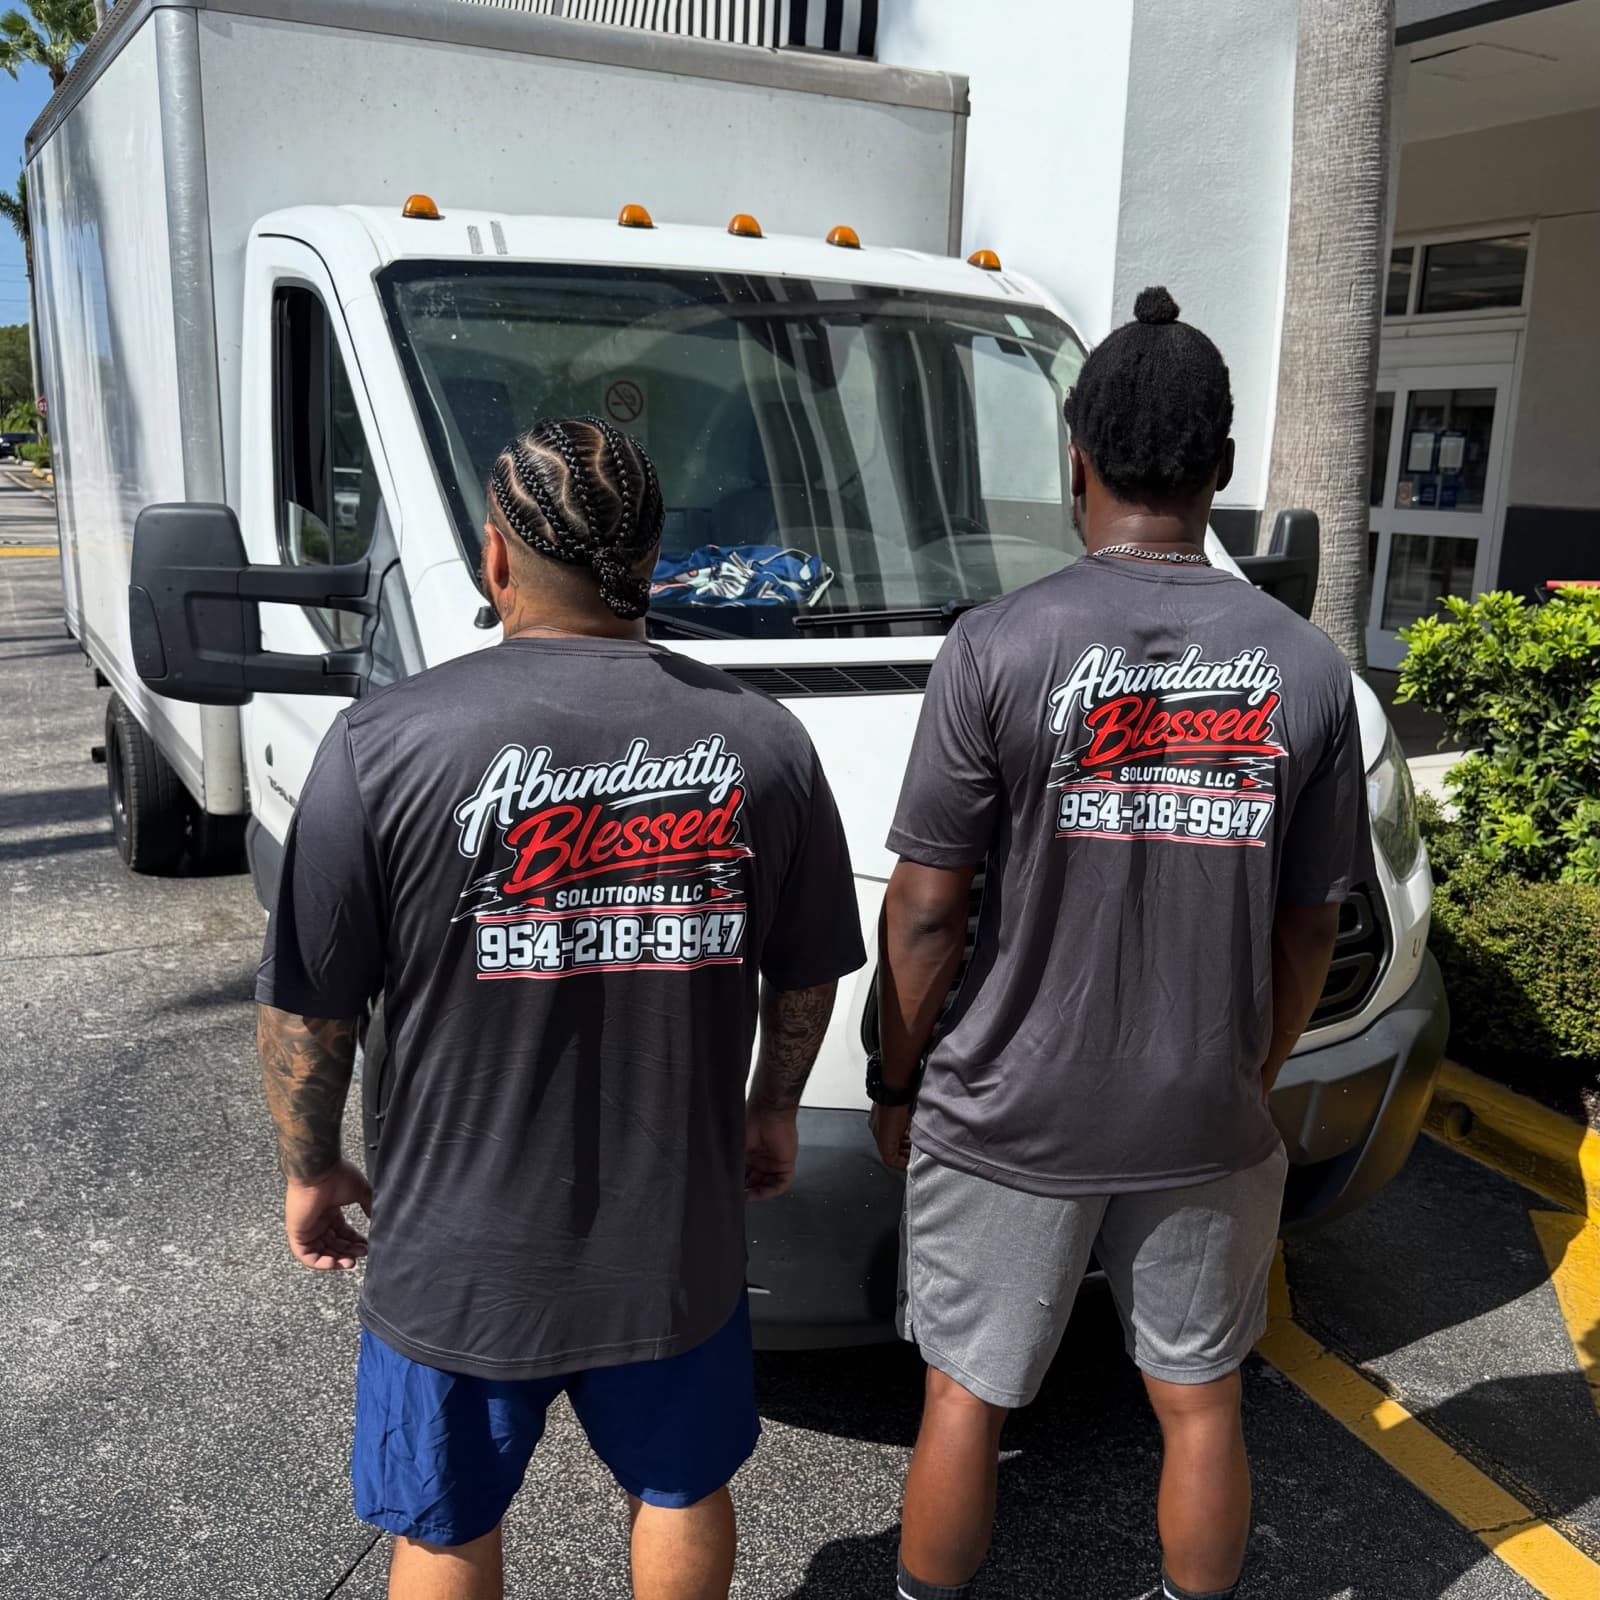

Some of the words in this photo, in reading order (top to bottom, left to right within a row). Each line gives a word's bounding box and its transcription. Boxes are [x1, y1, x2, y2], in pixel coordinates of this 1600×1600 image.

[1050, 645, 1281, 734] Abundantly
[1081, 695, 1280, 766] Blessed
[456, 735, 744, 856] Abundantly
[1120, 767, 1201, 785] SOLUTIONS
[1206, 771, 1236, 788] LLC
[503, 790, 742, 894] Blessed
[1058, 791, 1273, 838] 954-218-9947
[555, 885, 664, 909] SOLUTIONS
[671, 882, 704, 903] LLC
[478, 912, 745, 970] 954-218-9947
